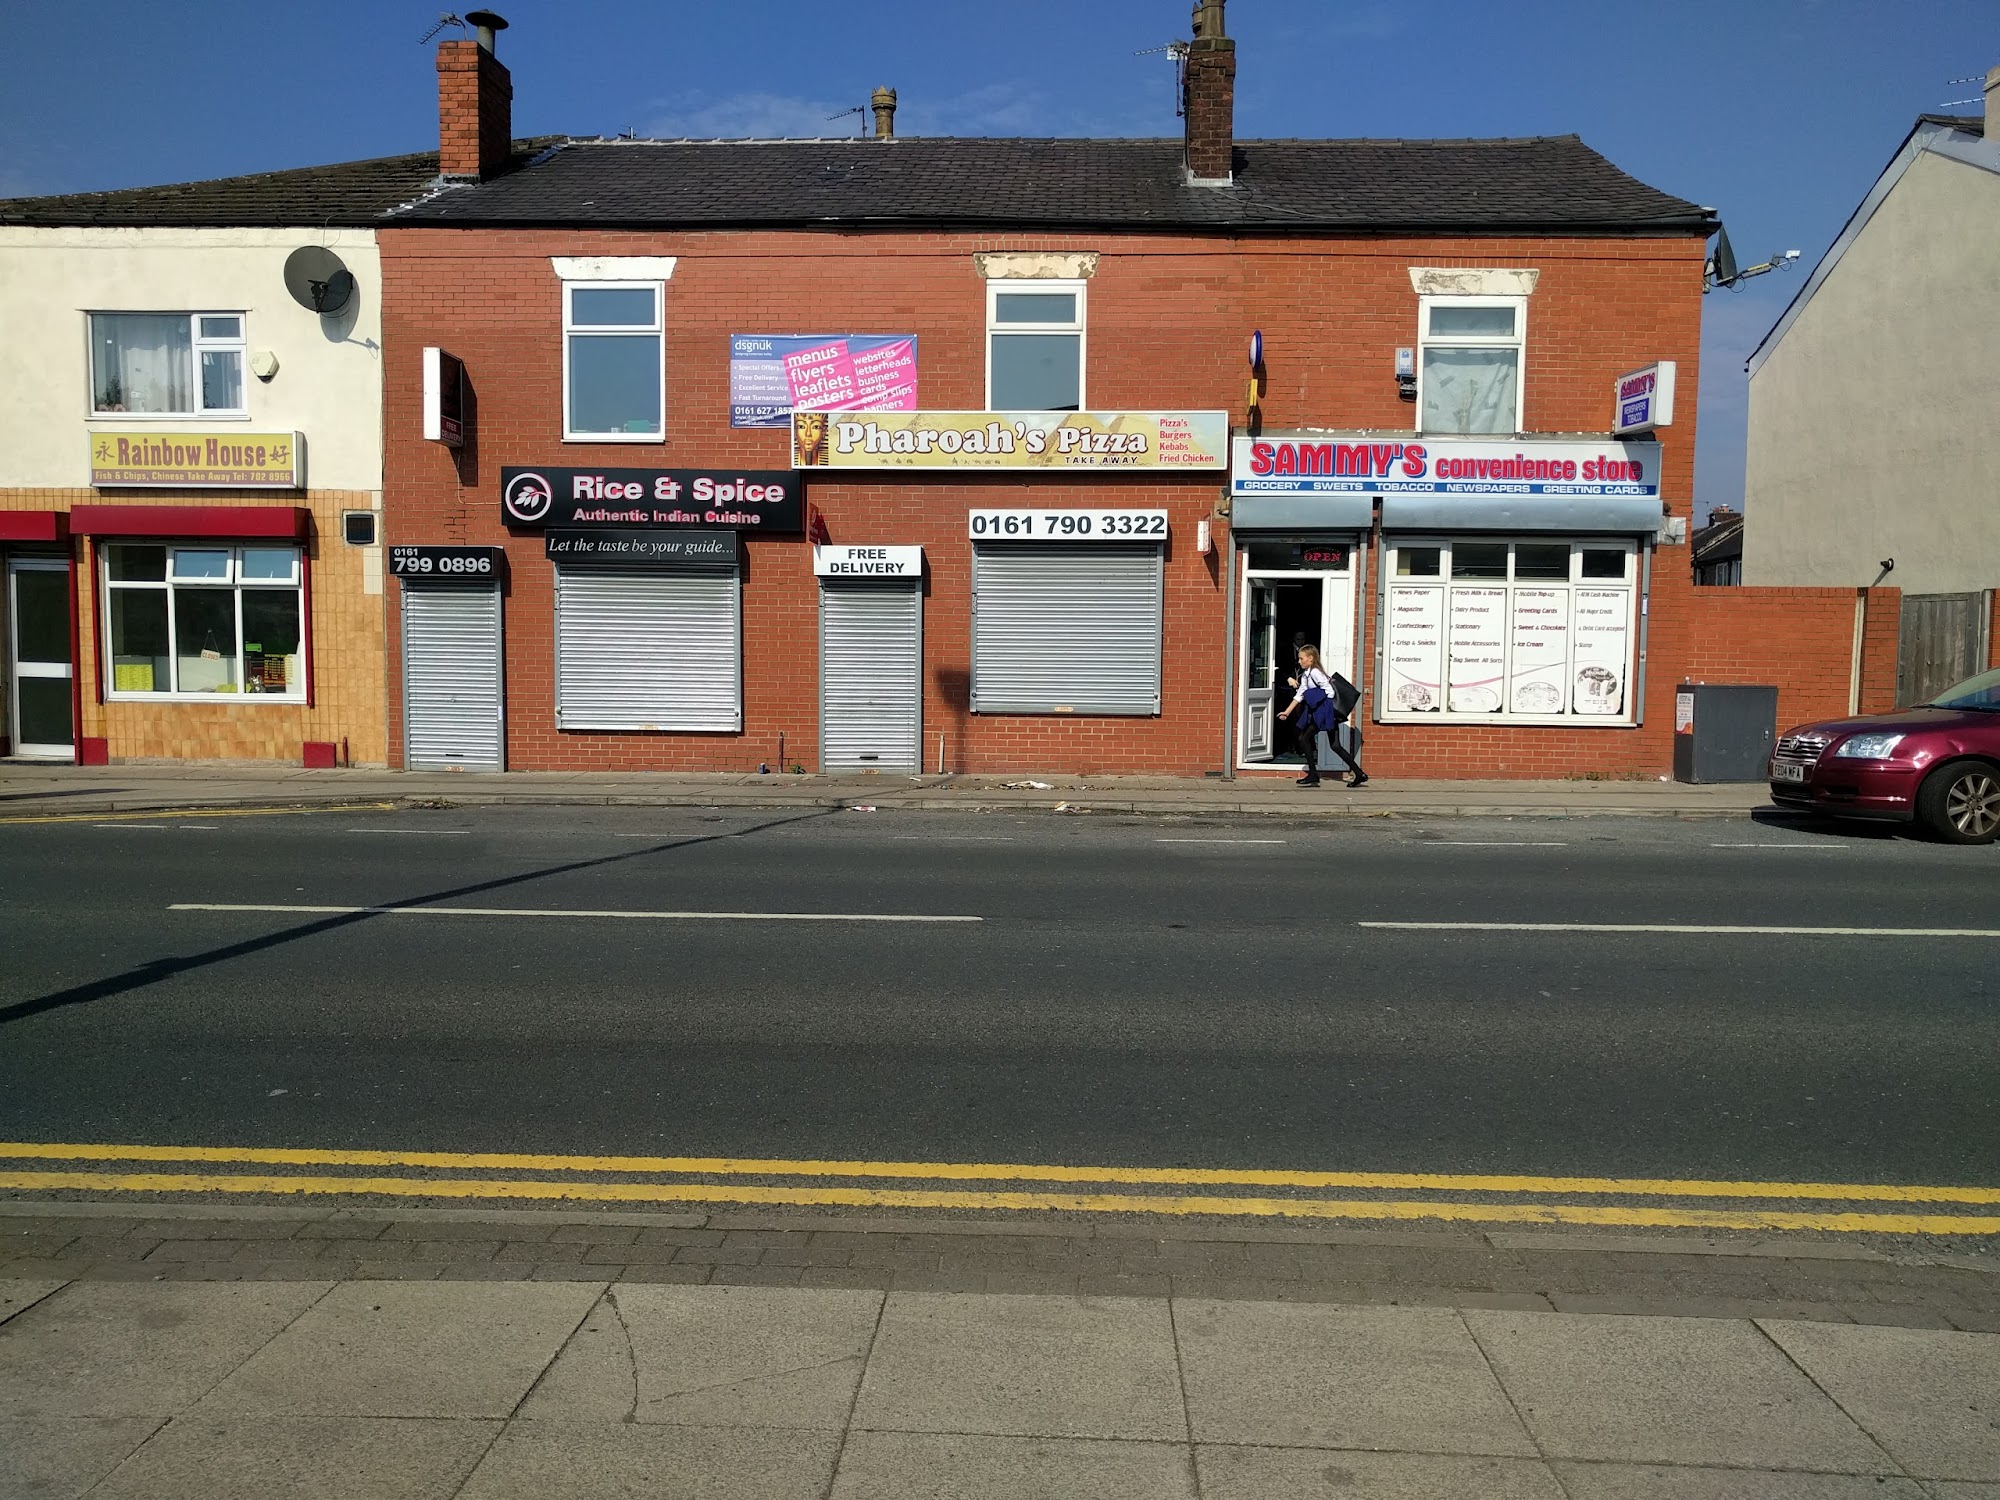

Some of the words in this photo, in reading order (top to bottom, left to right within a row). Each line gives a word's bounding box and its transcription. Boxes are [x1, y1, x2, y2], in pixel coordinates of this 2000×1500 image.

[734, 340, 772, 352] dsgnuk
[788, 346, 838, 368] menus
[853, 349, 896, 366] websites
[856, 356, 911, 376] letterheads
[790, 364, 835, 383] flyers
[858, 370, 900, 387] business
[794, 375, 852, 398] leaflets
[860, 383, 887, 395] cards
[1621, 372, 1655, 400] SAMMY'S
[798, 388, 854, 410] posters
[862, 392, 888, 404] comp
[890, 386, 912, 398] slips
[735, 406, 754, 414] 0161
[756, 406, 771, 414] 627
[774, 406, 793, 415] 1857
[864, 400, 904, 411] banners
[1624, 401, 1646, 414] NEWSPAPERS
[1160, 419, 1188, 427] Pizza's
[1627, 412, 1642, 424] TOBACCO
[446, 422, 457, 432] FREE
[442, 429, 461, 442] DELIVERY
[836, 421, 1046, 456] Pharoah's
[1057, 427, 1148, 454] Pizza
[1160, 431, 1192, 440] Burgers
[95, 441, 115, 462] 永
[117, 438, 201, 466] Rainbow
[206, 438, 266, 466] House
[1160, 442, 1188, 451] Kebabs
[270, 445, 290, 465] 好
[1159, 454, 1180, 462] Fried
[1182, 454, 1214, 463] Chicken
[1250, 442, 1427, 478] SAMMY'S
[1435, 454, 1577, 481] convenience
[1582, 455, 1643, 482] store
[96, 472, 112, 480] Fish
[115, 472, 121, 480] &
[124, 472, 149, 482] Chips,
[152, 472, 184, 481] Chinese
[188, 472, 205, 481] Take
[208, 472, 230, 482] Away
[233, 472, 247, 481] Tel:
[250, 473, 266, 481] 702
[269, 473, 290, 481] 8966
[573, 475, 644, 500] Rice
[654, 476, 682, 500] &
[692, 478, 785, 506] Spice
[1244, 482, 1301, 490] GROCERY
[1313, 482, 1364, 491] SWEETS
[1376, 483, 1434, 491] TOBACCO
[1446, 484, 1530, 493] NEWSPAPERS
[1542, 485, 1601, 494] GREETING
[1605, 486, 1648, 494] CARDS
[573, 509, 649, 522] Authentic
[653, 510, 700, 522] Indian
[704, 511, 761, 524] Cuisine
[972, 515, 1033, 534] 0161
[1044, 516, 1092, 535] 790
[1101, 516, 1165, 535] 3322
[394, 548, 418, 556] 0161
[550, 538, 571, 551] Let
[574, 538, 594, 552] the
[598, 540, 629, 552] taste
[632, 539, 648, 552] be
[650, 542, 682, 556] your
[685, 540, 734, 556] guide...
[848, 549, 887, 560] FREE
[1304, 552, 1341, 562] OPEN
[394, 558, 433, 572] 799
[439, 558, 491, 572] 0896
[830, 562, 905, 574] DELIVERY
[202, 651, 219, 660] CLOSED
